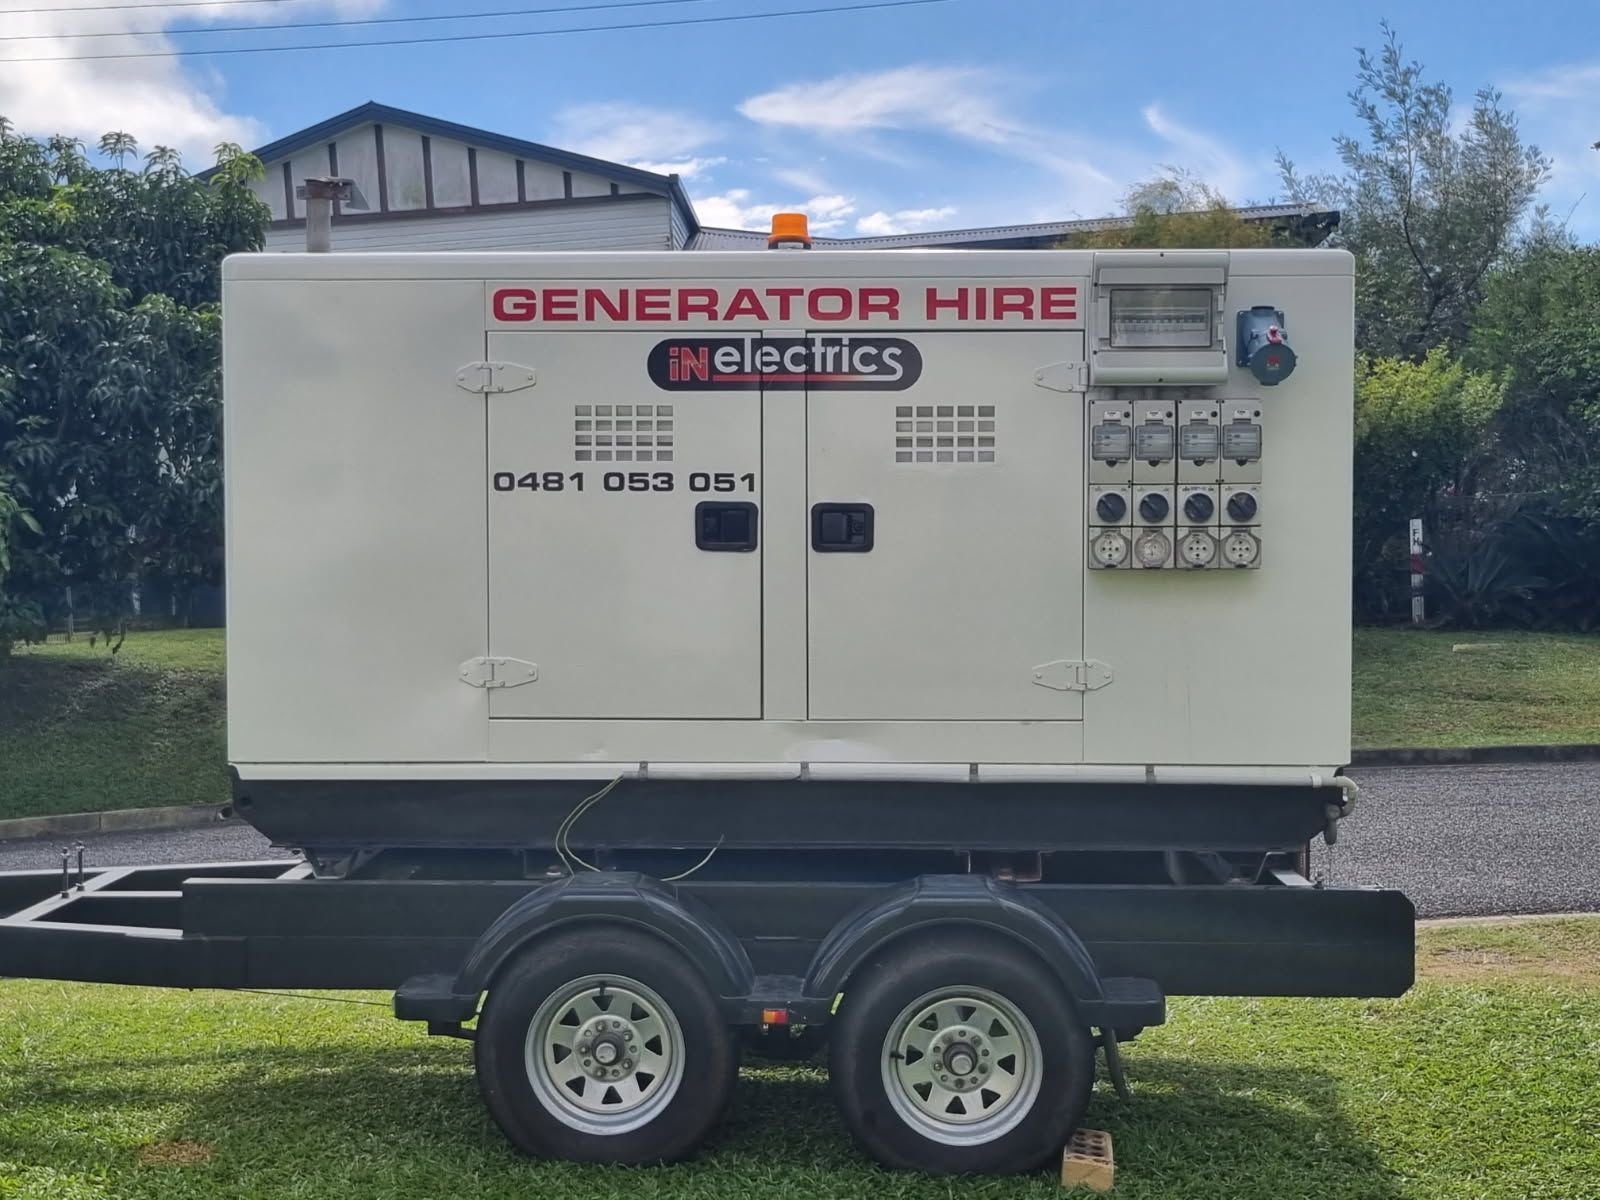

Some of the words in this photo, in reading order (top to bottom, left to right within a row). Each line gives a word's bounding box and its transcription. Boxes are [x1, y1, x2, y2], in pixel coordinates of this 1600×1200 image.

[493, 287, 900, 321] GENERATOR
[926, 287, 1077, 320] HIRE
[714, 337, 903, 381] electrics
[493, 472, 584, 492] 0481
[603, 472, 675, 492] 053
[689, 472, 755, 493] 051
